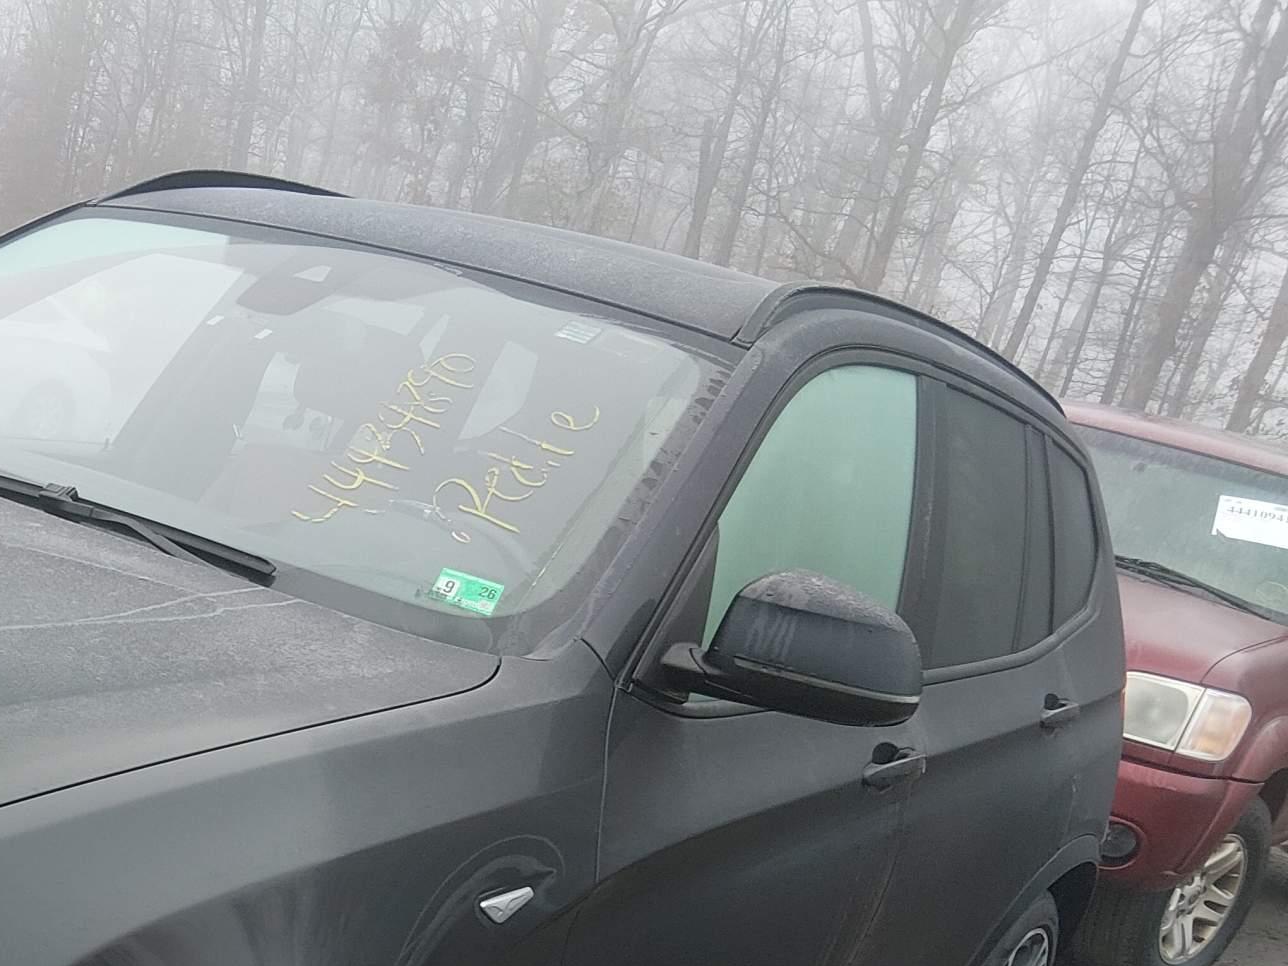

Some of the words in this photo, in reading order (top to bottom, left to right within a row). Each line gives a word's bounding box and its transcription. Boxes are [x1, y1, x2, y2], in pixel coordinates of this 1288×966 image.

[1226, 505, 1288, 523] 4441094
[443, 580, 456, 594] 9
[479, 586, 497, 600] 26
